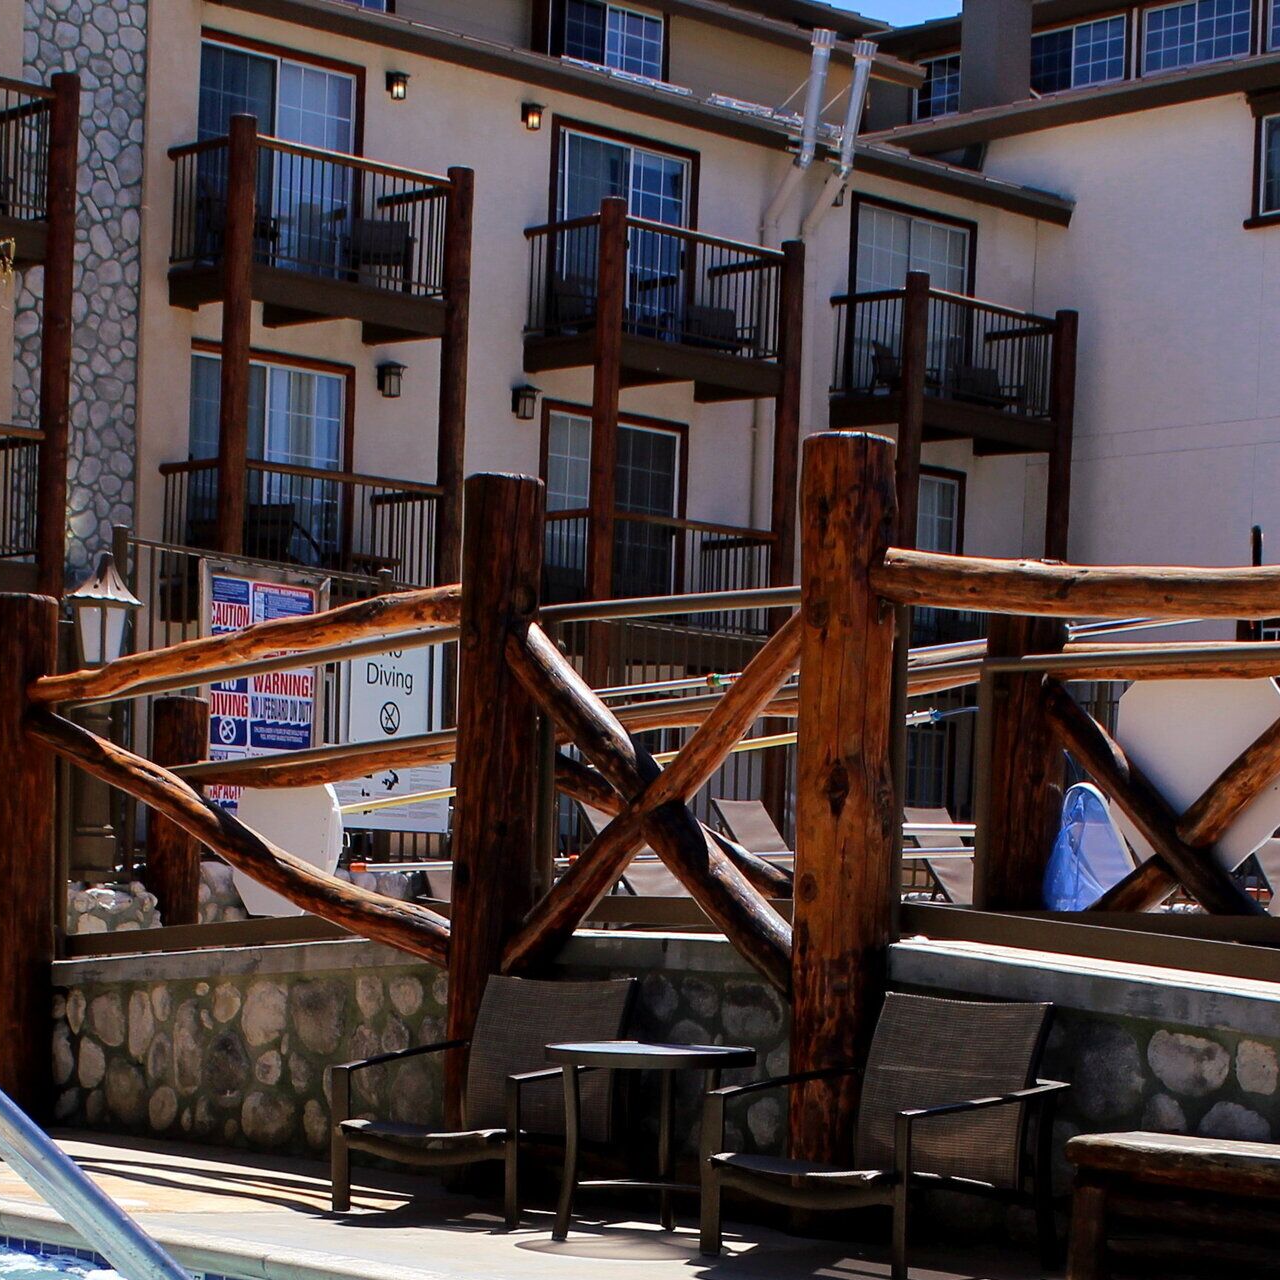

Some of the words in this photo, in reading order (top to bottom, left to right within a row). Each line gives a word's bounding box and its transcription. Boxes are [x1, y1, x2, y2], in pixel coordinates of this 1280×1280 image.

[253, 672, 314, 698] WARNING!
[366, 662, 414, 696] Diving
[210, 692, 249, 718] DIVING
